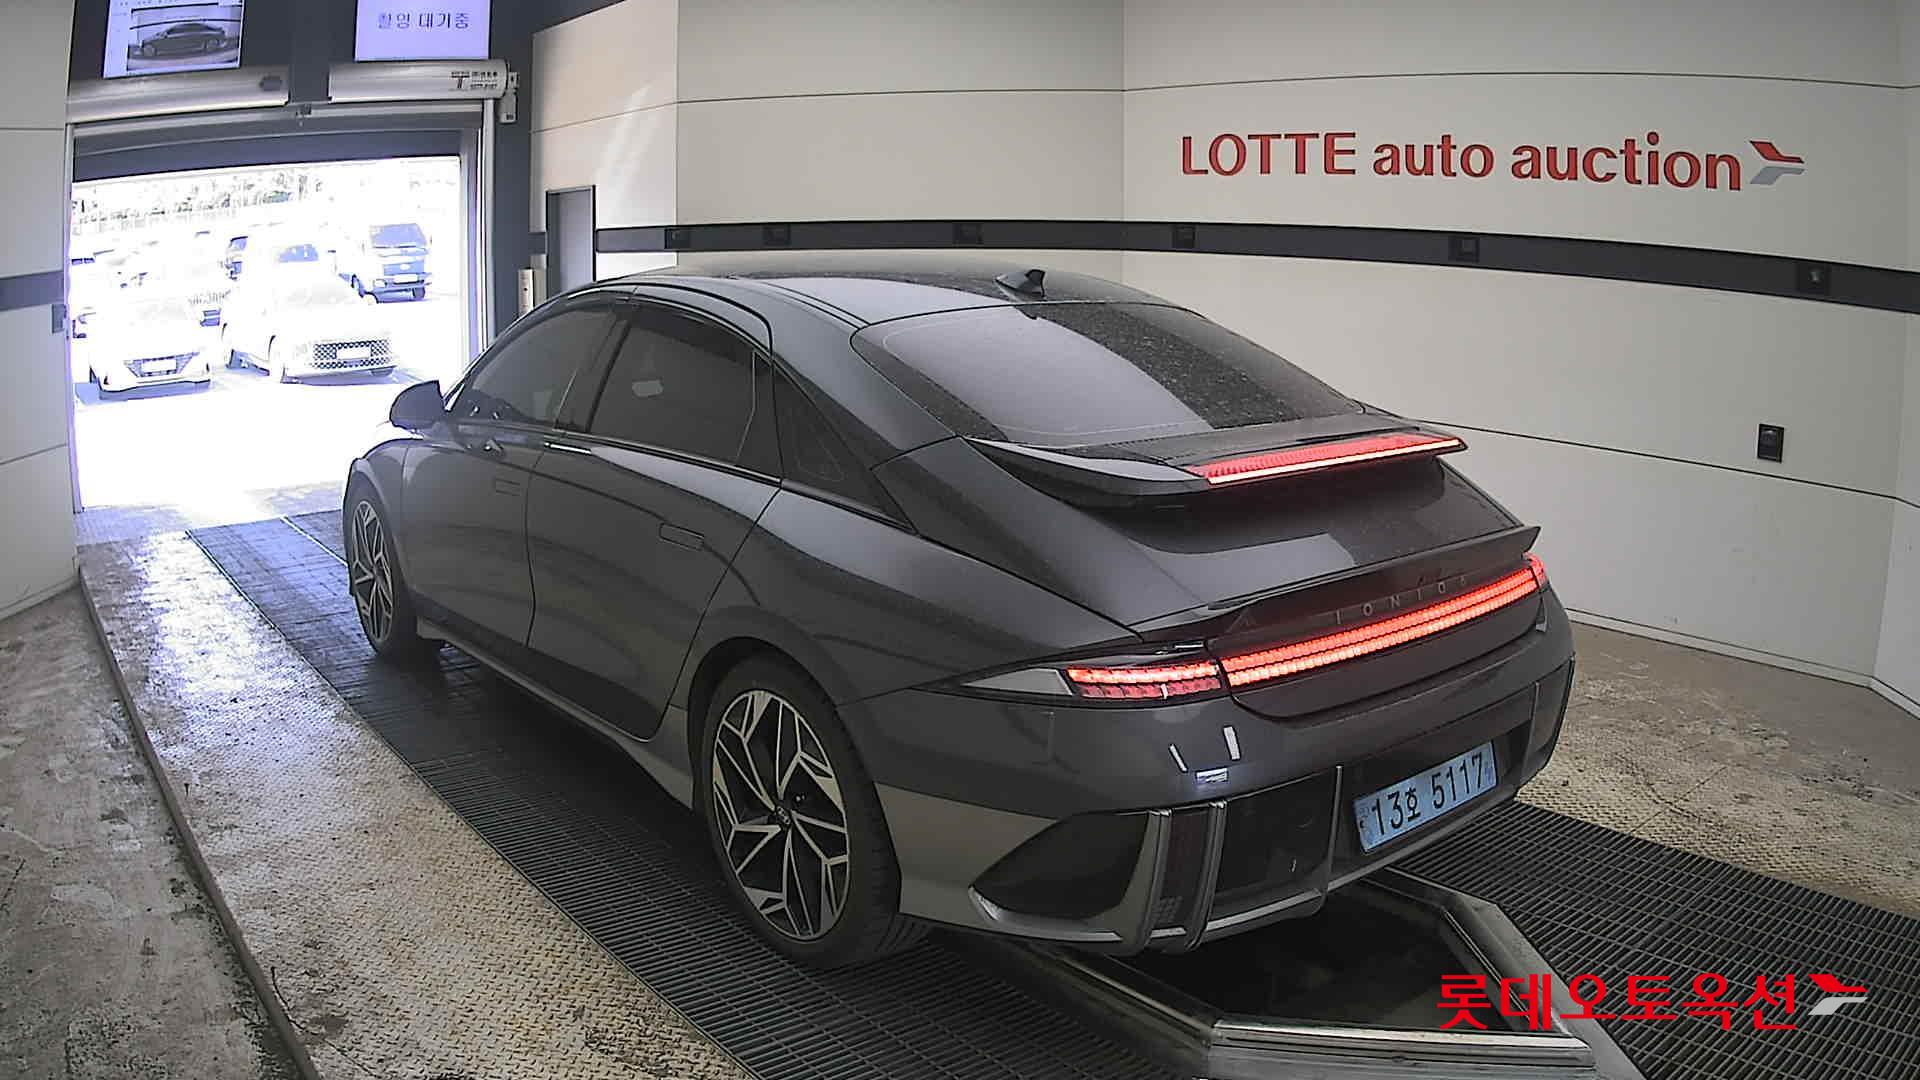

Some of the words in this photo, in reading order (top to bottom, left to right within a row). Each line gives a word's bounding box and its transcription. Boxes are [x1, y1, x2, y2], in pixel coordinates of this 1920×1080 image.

[419, 11, 469, 30] 대기중
[1182, 131, 1356, 177] LOTTE
[1373, 133, 1495, 178] auto
[1511, 131, 1741, 191] auction
[1371, 787, 1421, 836] 13호
[1431, 751, 1482, 810] 5117
